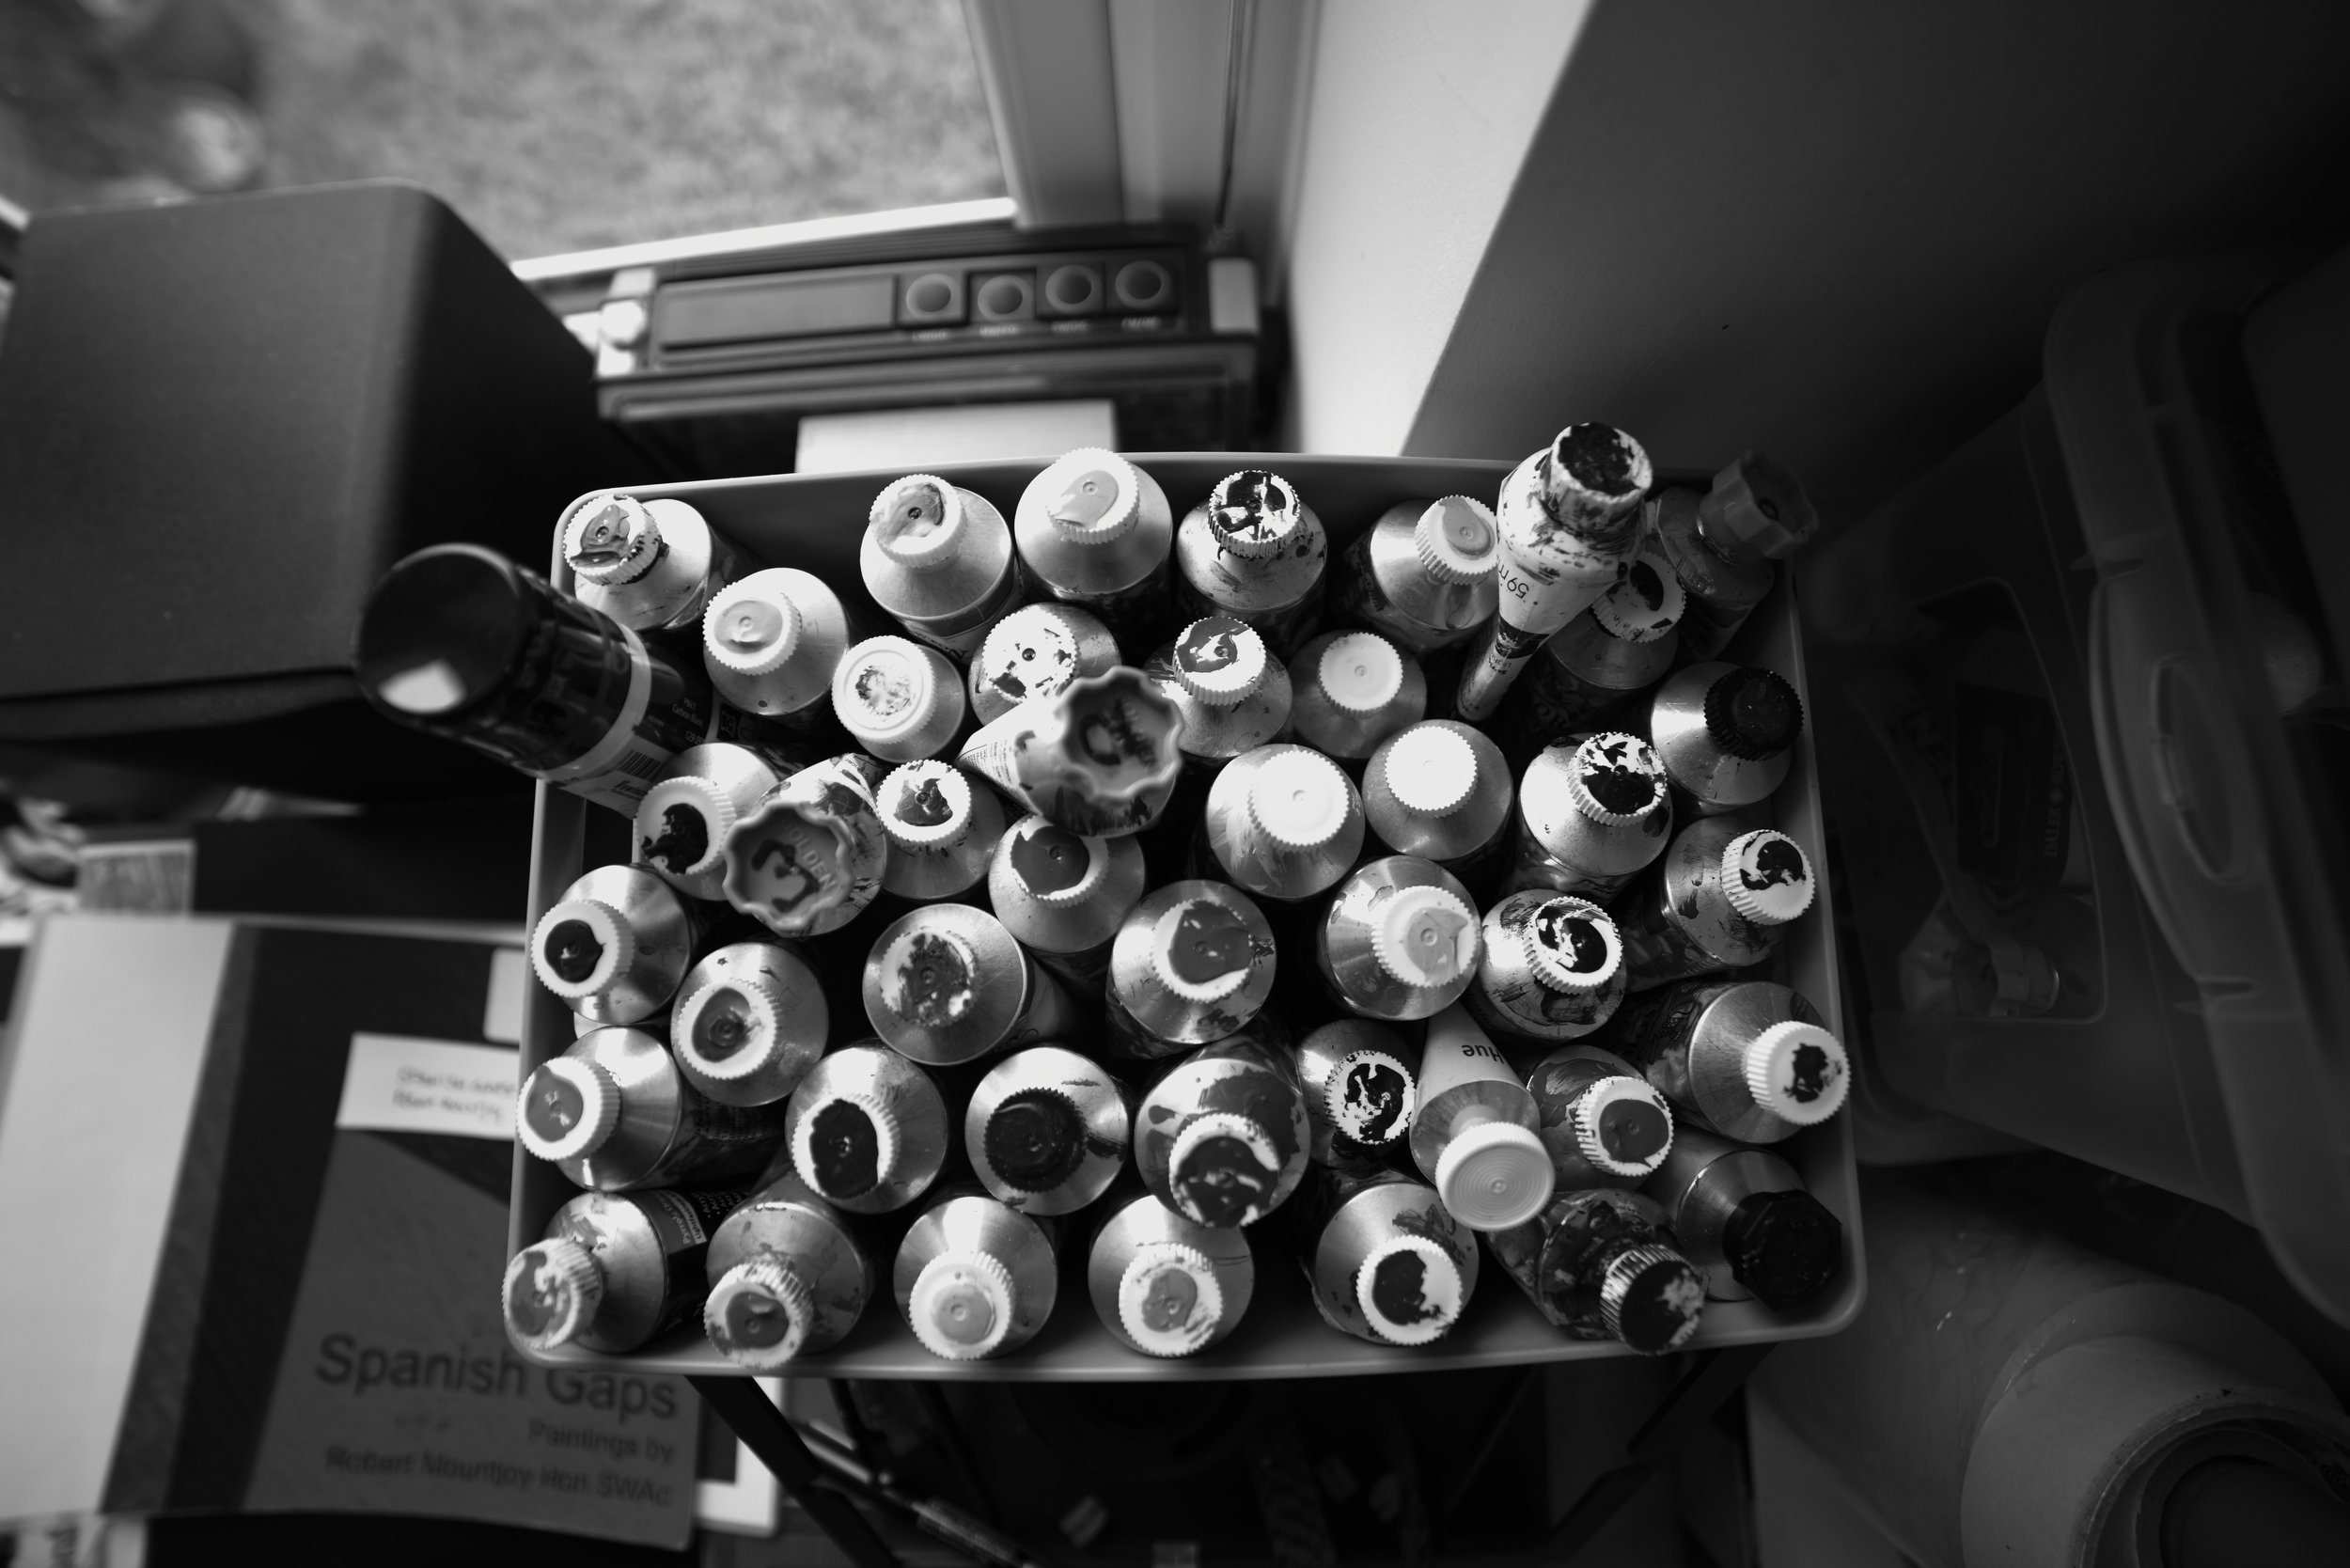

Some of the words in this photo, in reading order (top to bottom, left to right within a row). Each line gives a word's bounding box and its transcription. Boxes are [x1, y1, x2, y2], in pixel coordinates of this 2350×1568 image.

[783, 821, 837, 891] OLDEN
[2044, 807, 2061, 858] DALER
[1462, 1043, 1504, 1064] Hue
[315, 1332, 525, 1398] Spanish
[545, 1369, 678, 1424] Gaps
[528, 1419, 638, 1462] Paintings
[645, 1433, 675, 1466] by
[325, 1444, 415, 1477] Robert
[421, 1450, 533, 1490] Mountjoy
[540, 1466, 588, 1495] Hon
